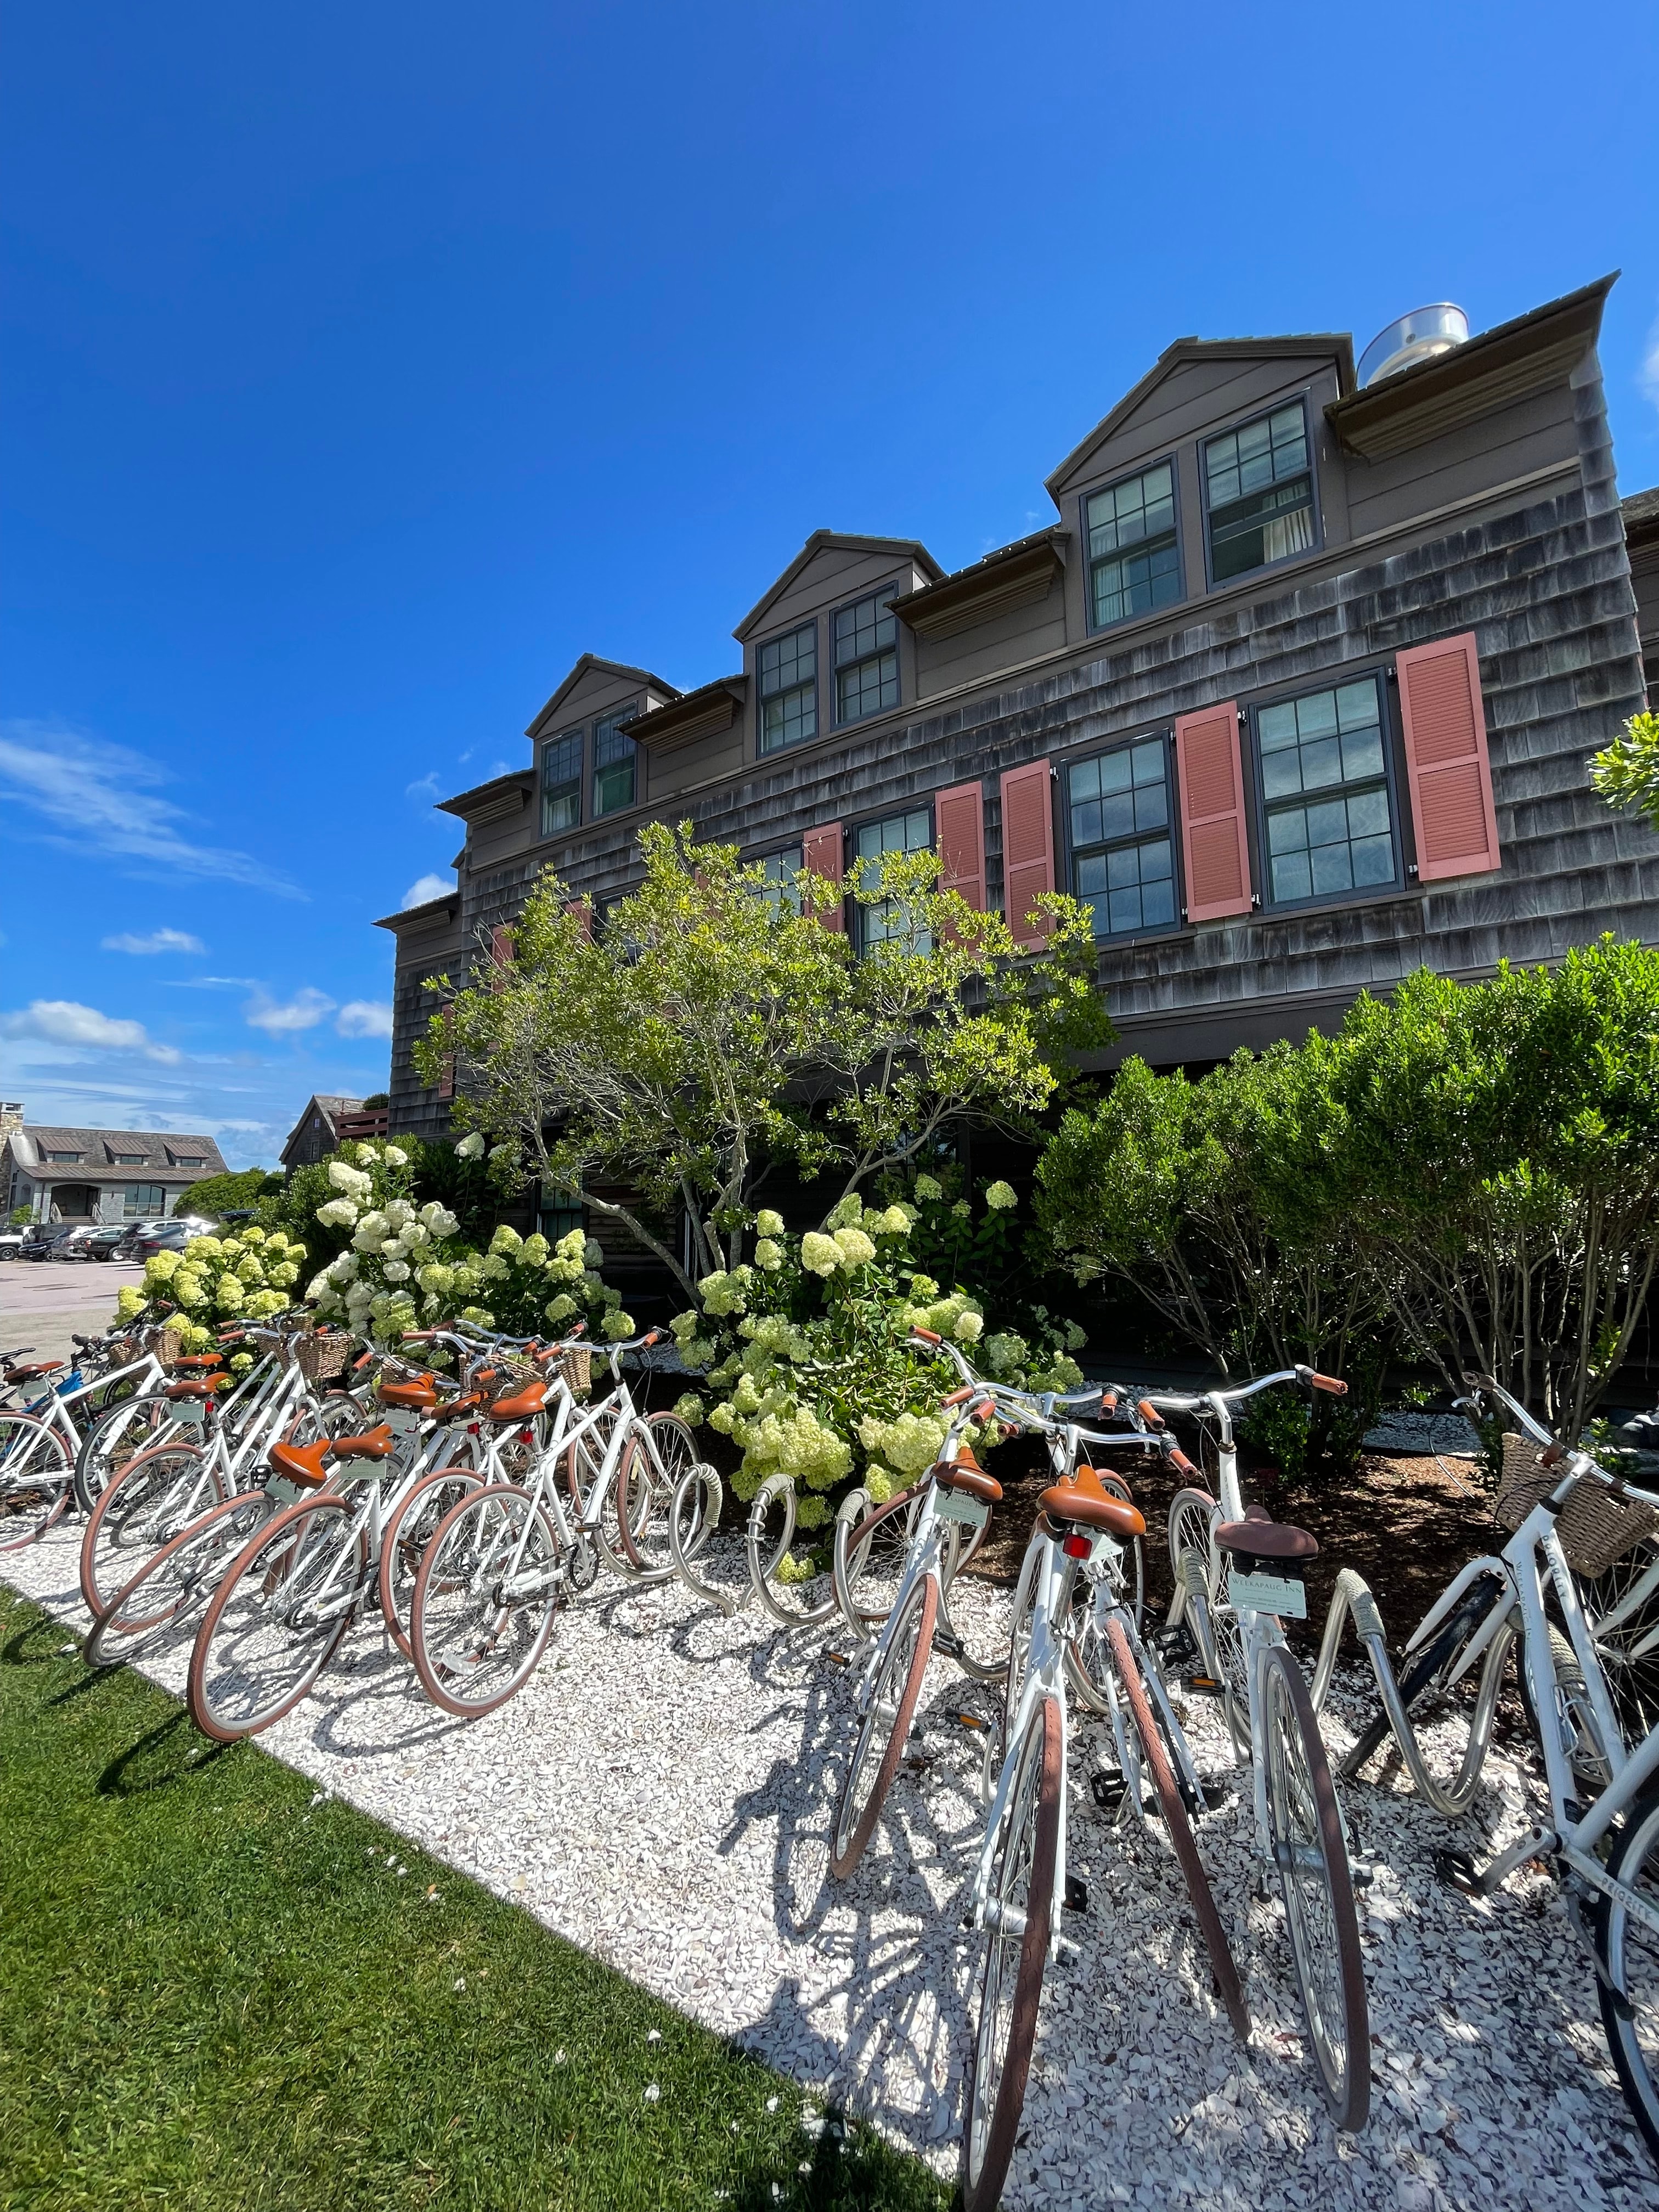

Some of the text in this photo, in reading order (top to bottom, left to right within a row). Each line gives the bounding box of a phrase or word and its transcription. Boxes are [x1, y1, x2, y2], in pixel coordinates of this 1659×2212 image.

[541, 1572, 562, 1584] PRIORITY
[1541, 1535, 1566, 1597] PRIORITY
[1232, 1577, 1282, 1591] WEEKAPAUG
[1285, 1584, 1302, 1594] INN
[1602, 1877, 1653, 1920] PRIORITY
